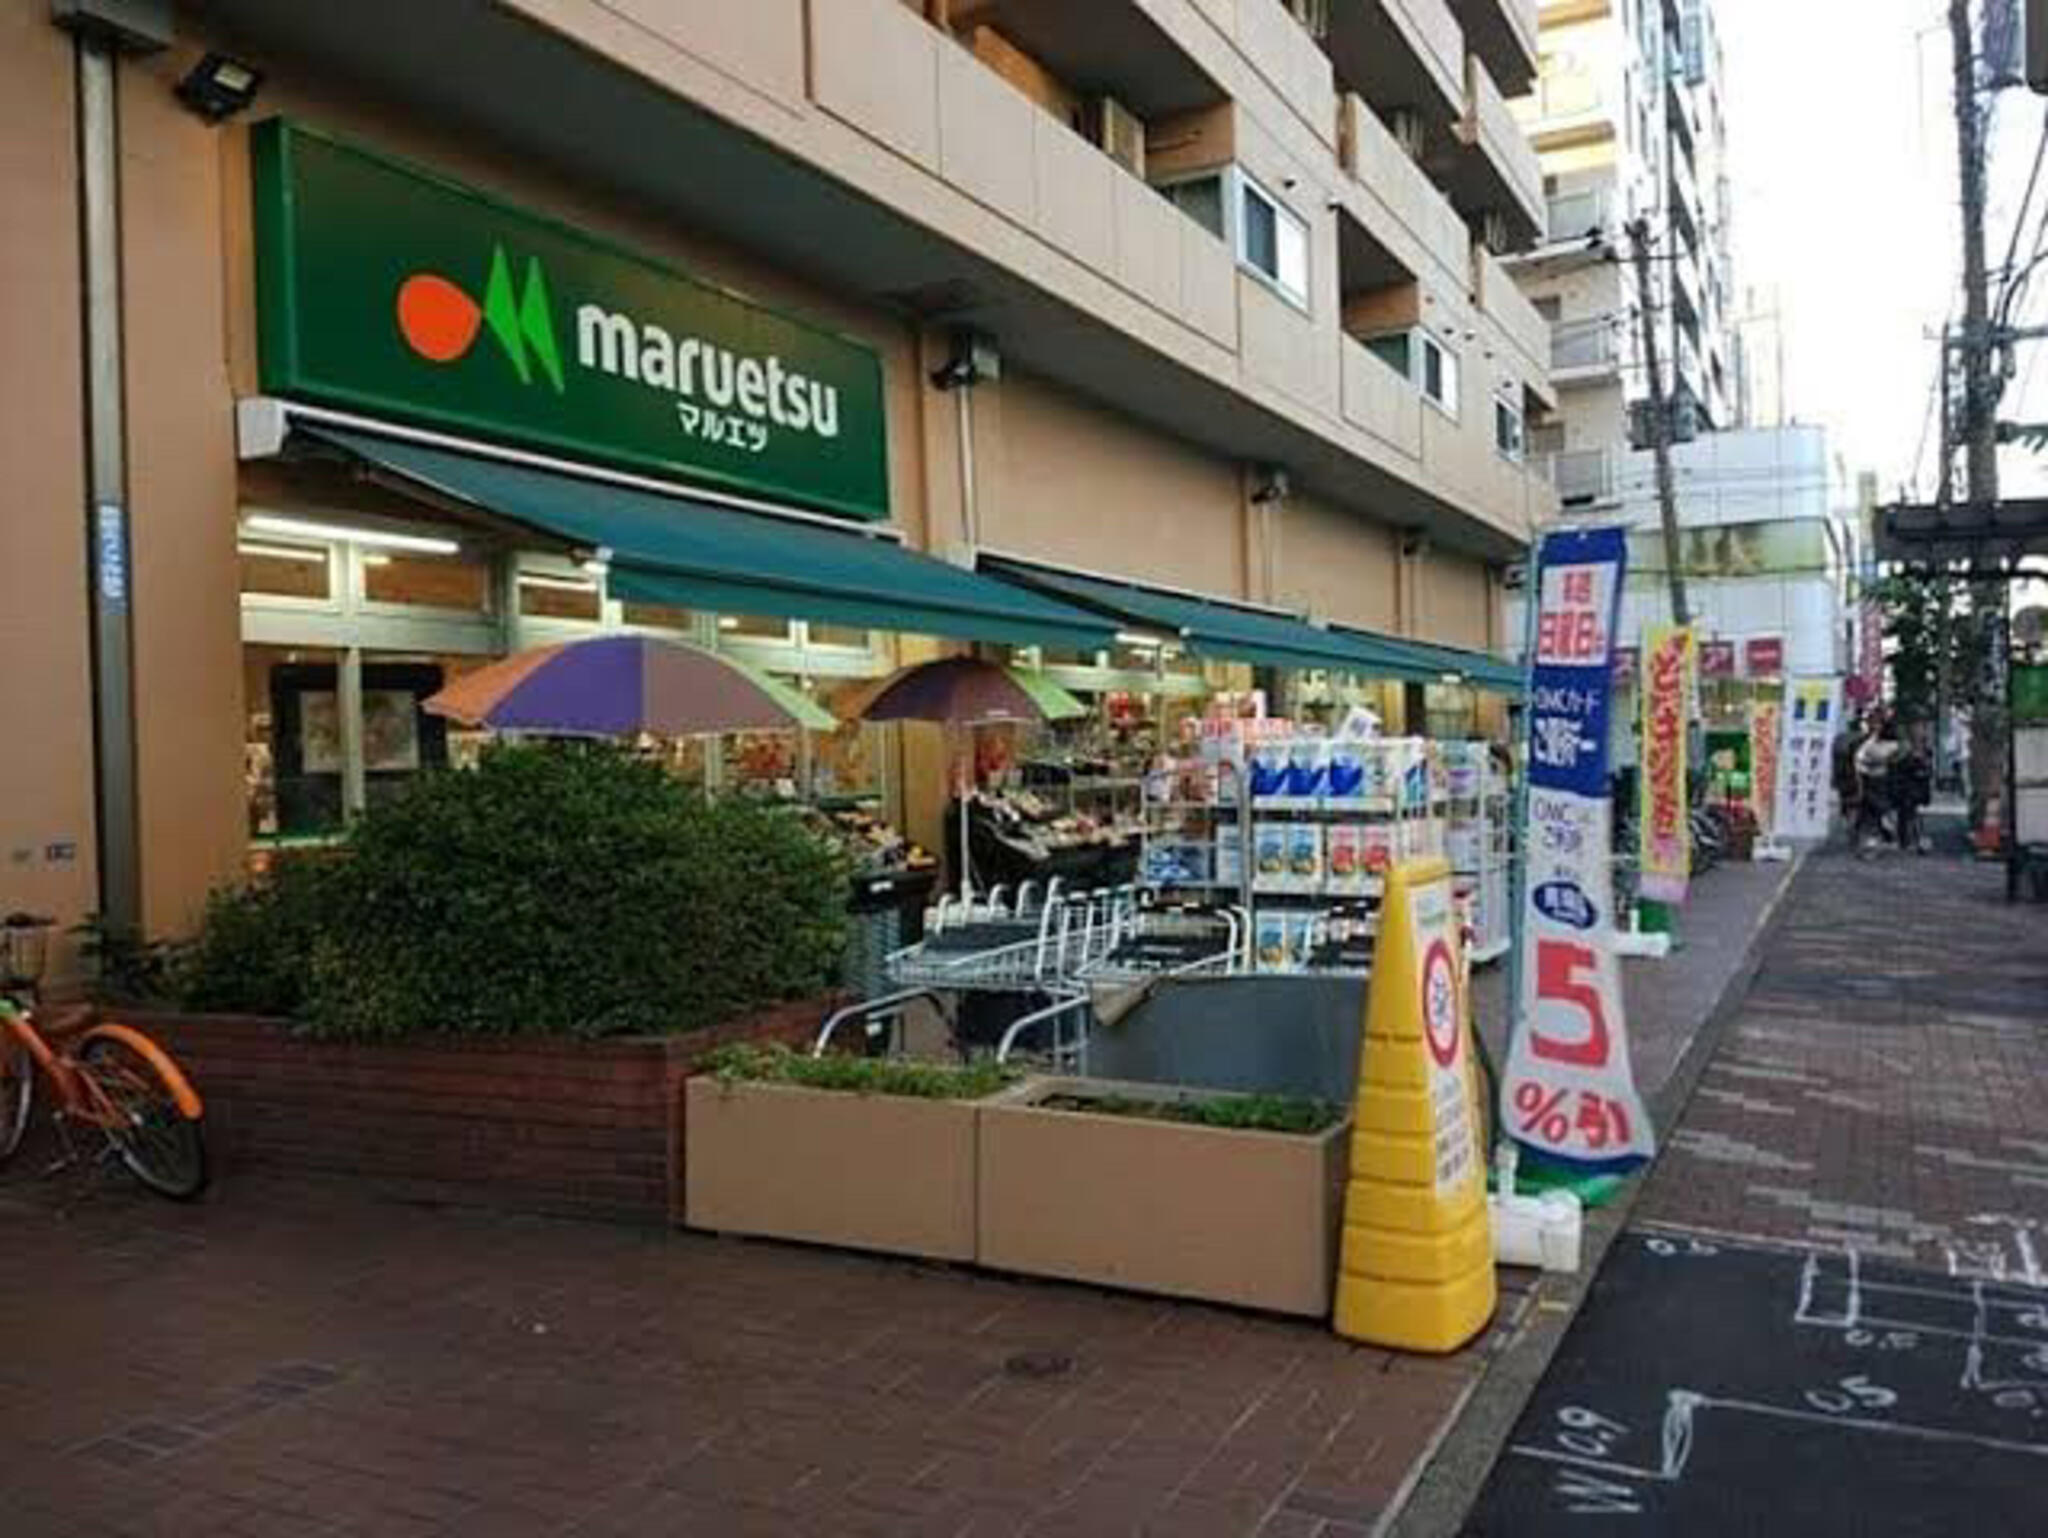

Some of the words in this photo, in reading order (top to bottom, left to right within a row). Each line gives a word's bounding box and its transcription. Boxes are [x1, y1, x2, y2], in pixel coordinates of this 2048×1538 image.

[577, 304, 838, 436] maruetsu
[676, 402, 768, 452] マルエツ
[1530, 938, 1610, 1068] 5
